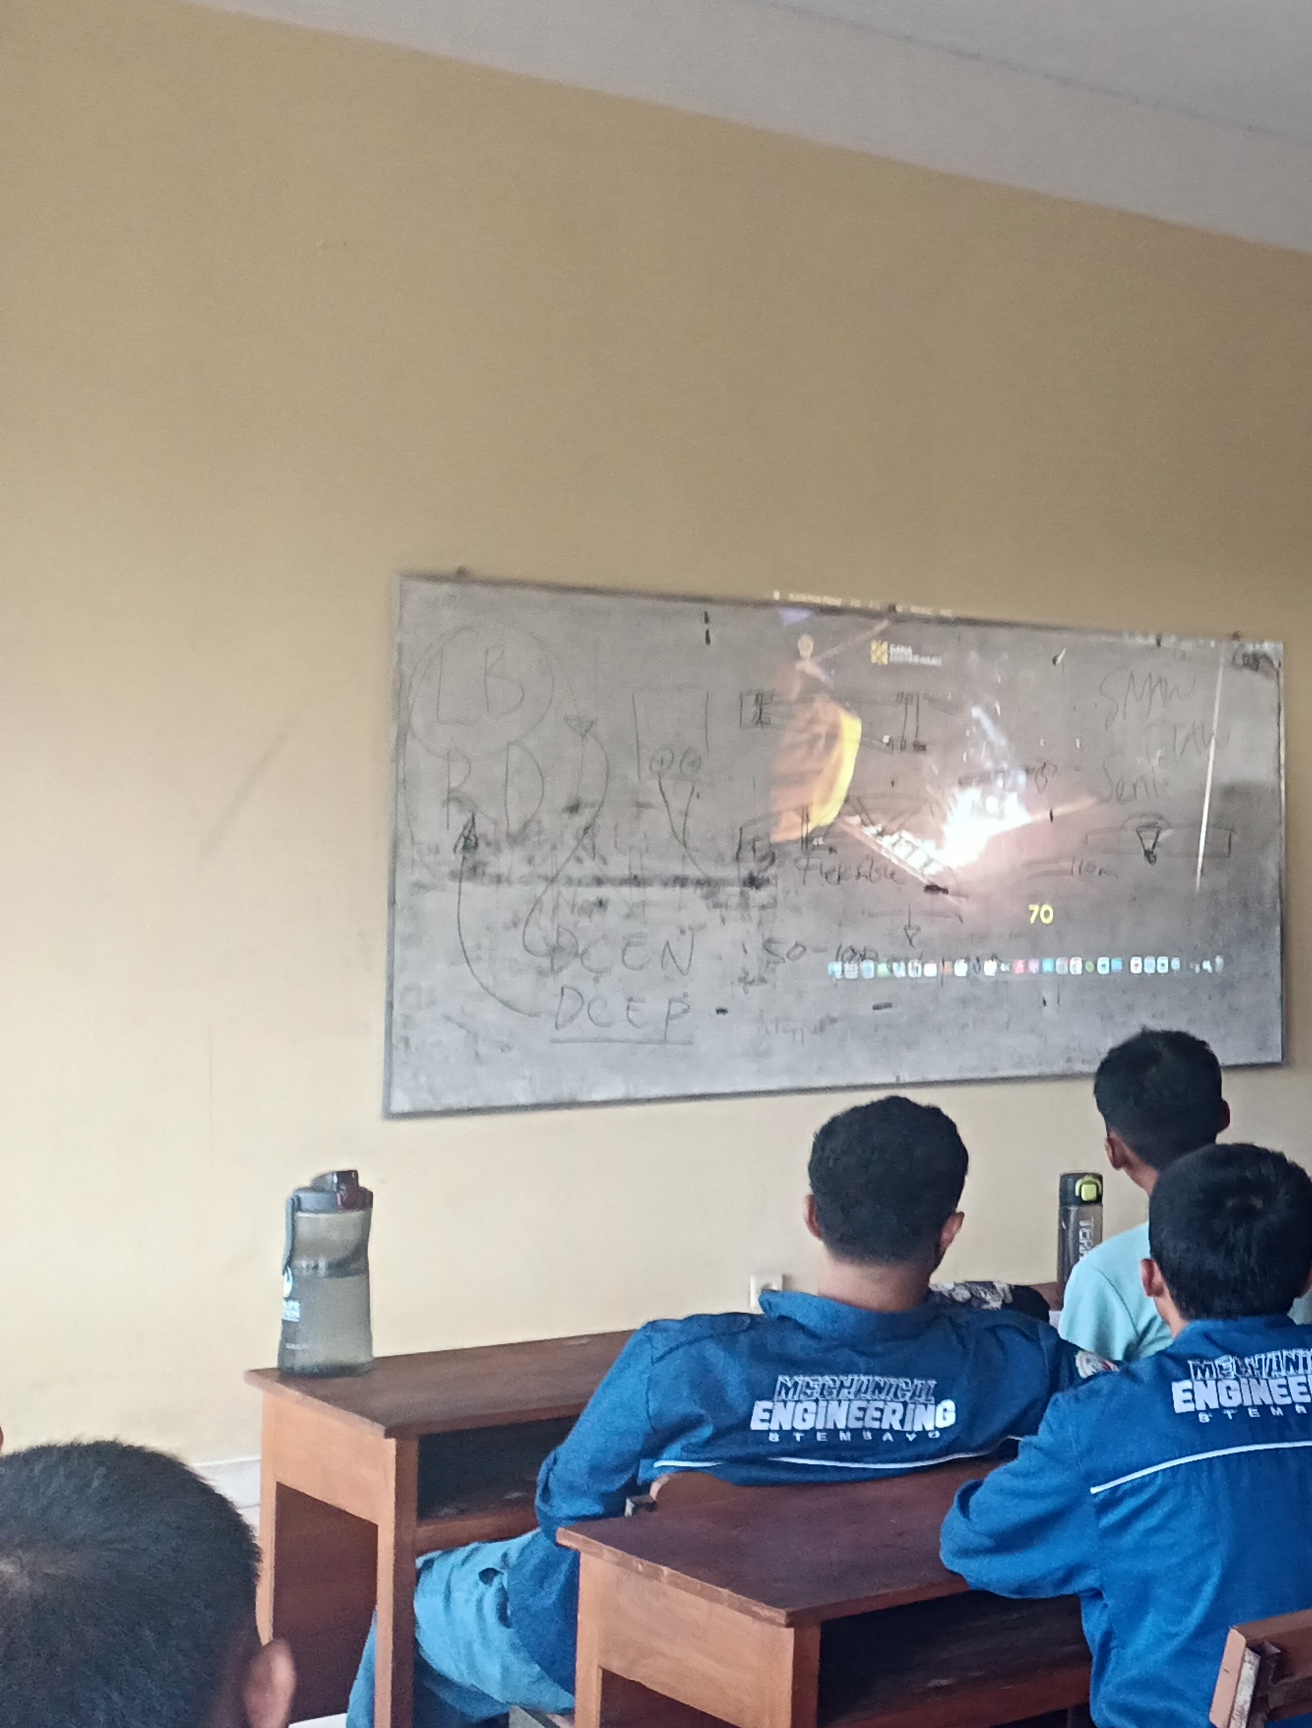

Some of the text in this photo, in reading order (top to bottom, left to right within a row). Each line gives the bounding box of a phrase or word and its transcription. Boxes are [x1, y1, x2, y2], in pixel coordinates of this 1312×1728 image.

[1028, 903, 1054, 925] 70
[556, 986, 691, 1041] DCEP
[750, 1399, 956, 1432] ENGINEERING
